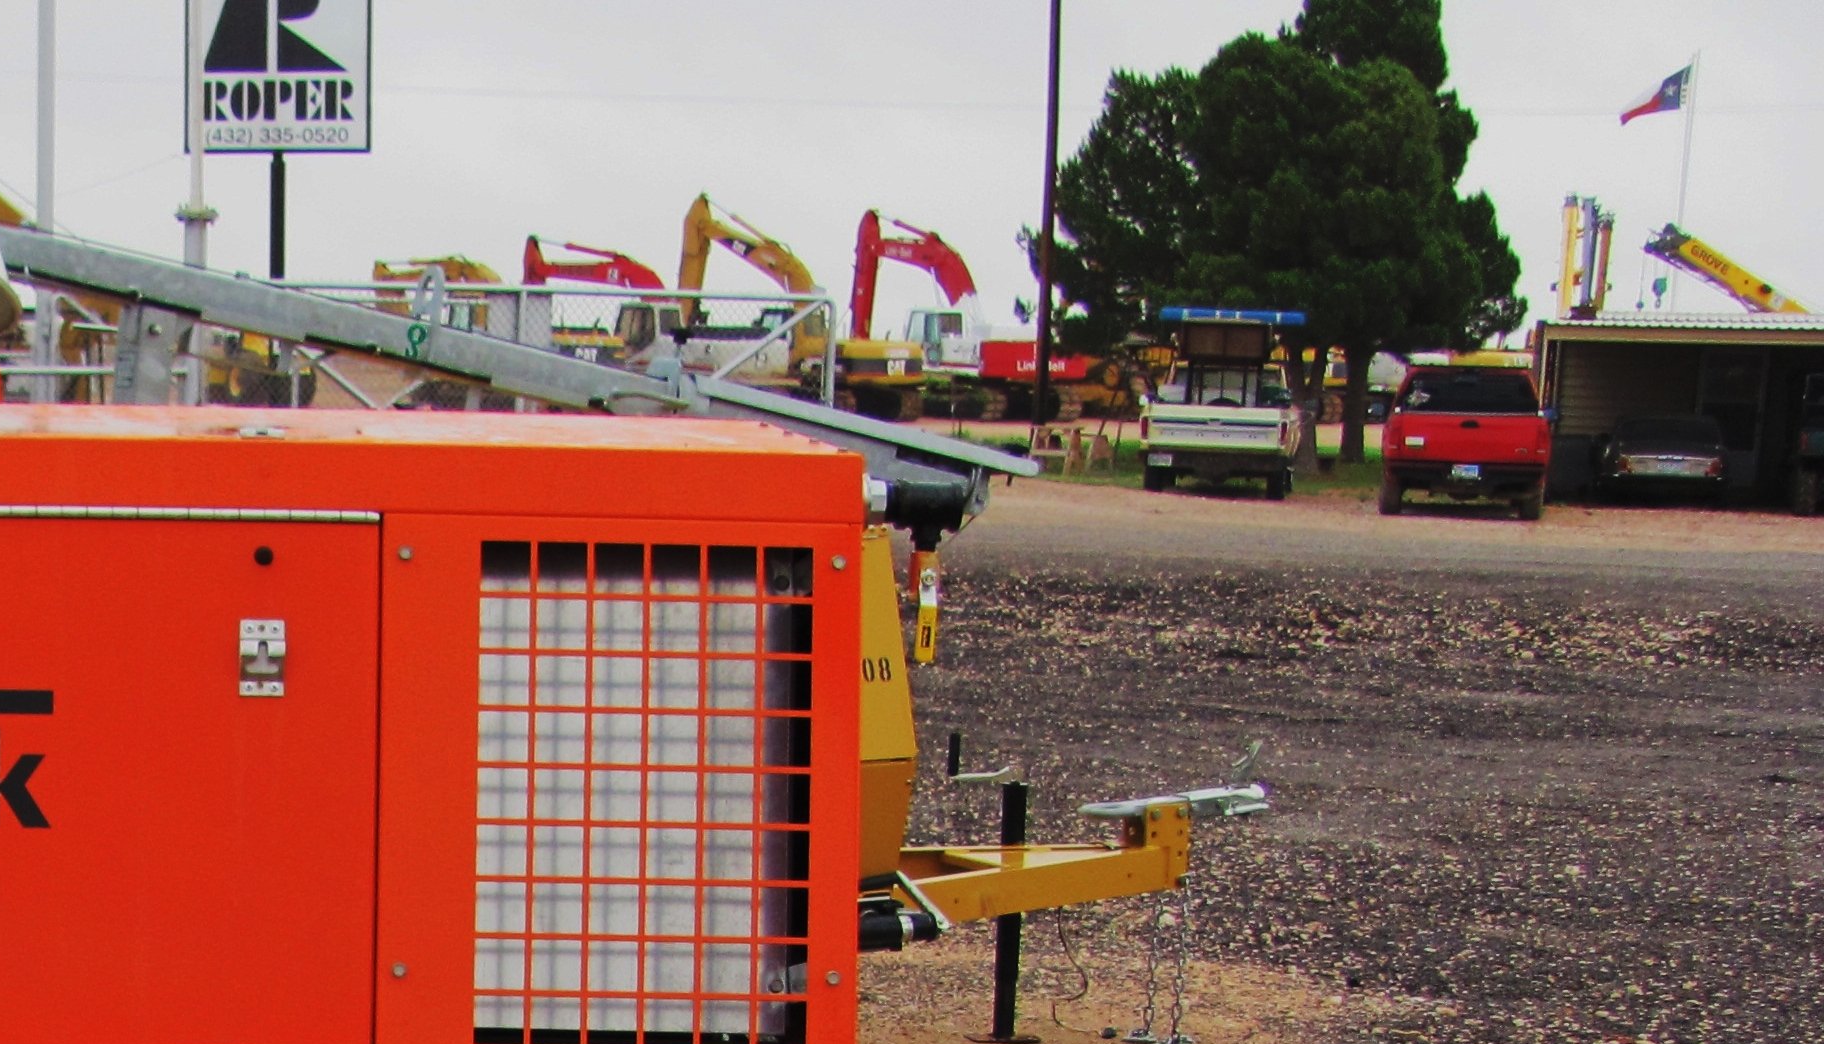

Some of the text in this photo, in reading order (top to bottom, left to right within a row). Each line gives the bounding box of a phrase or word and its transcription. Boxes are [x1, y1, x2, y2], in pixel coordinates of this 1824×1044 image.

[204, 80, 353, 121] ROPER
[206, 127, 349, 146] (432) 335-0520
[1690, 244, 1730, 276] GROVE
[574, 347, 597, 362] CAT
[887, 359, 906, 376] CAT
